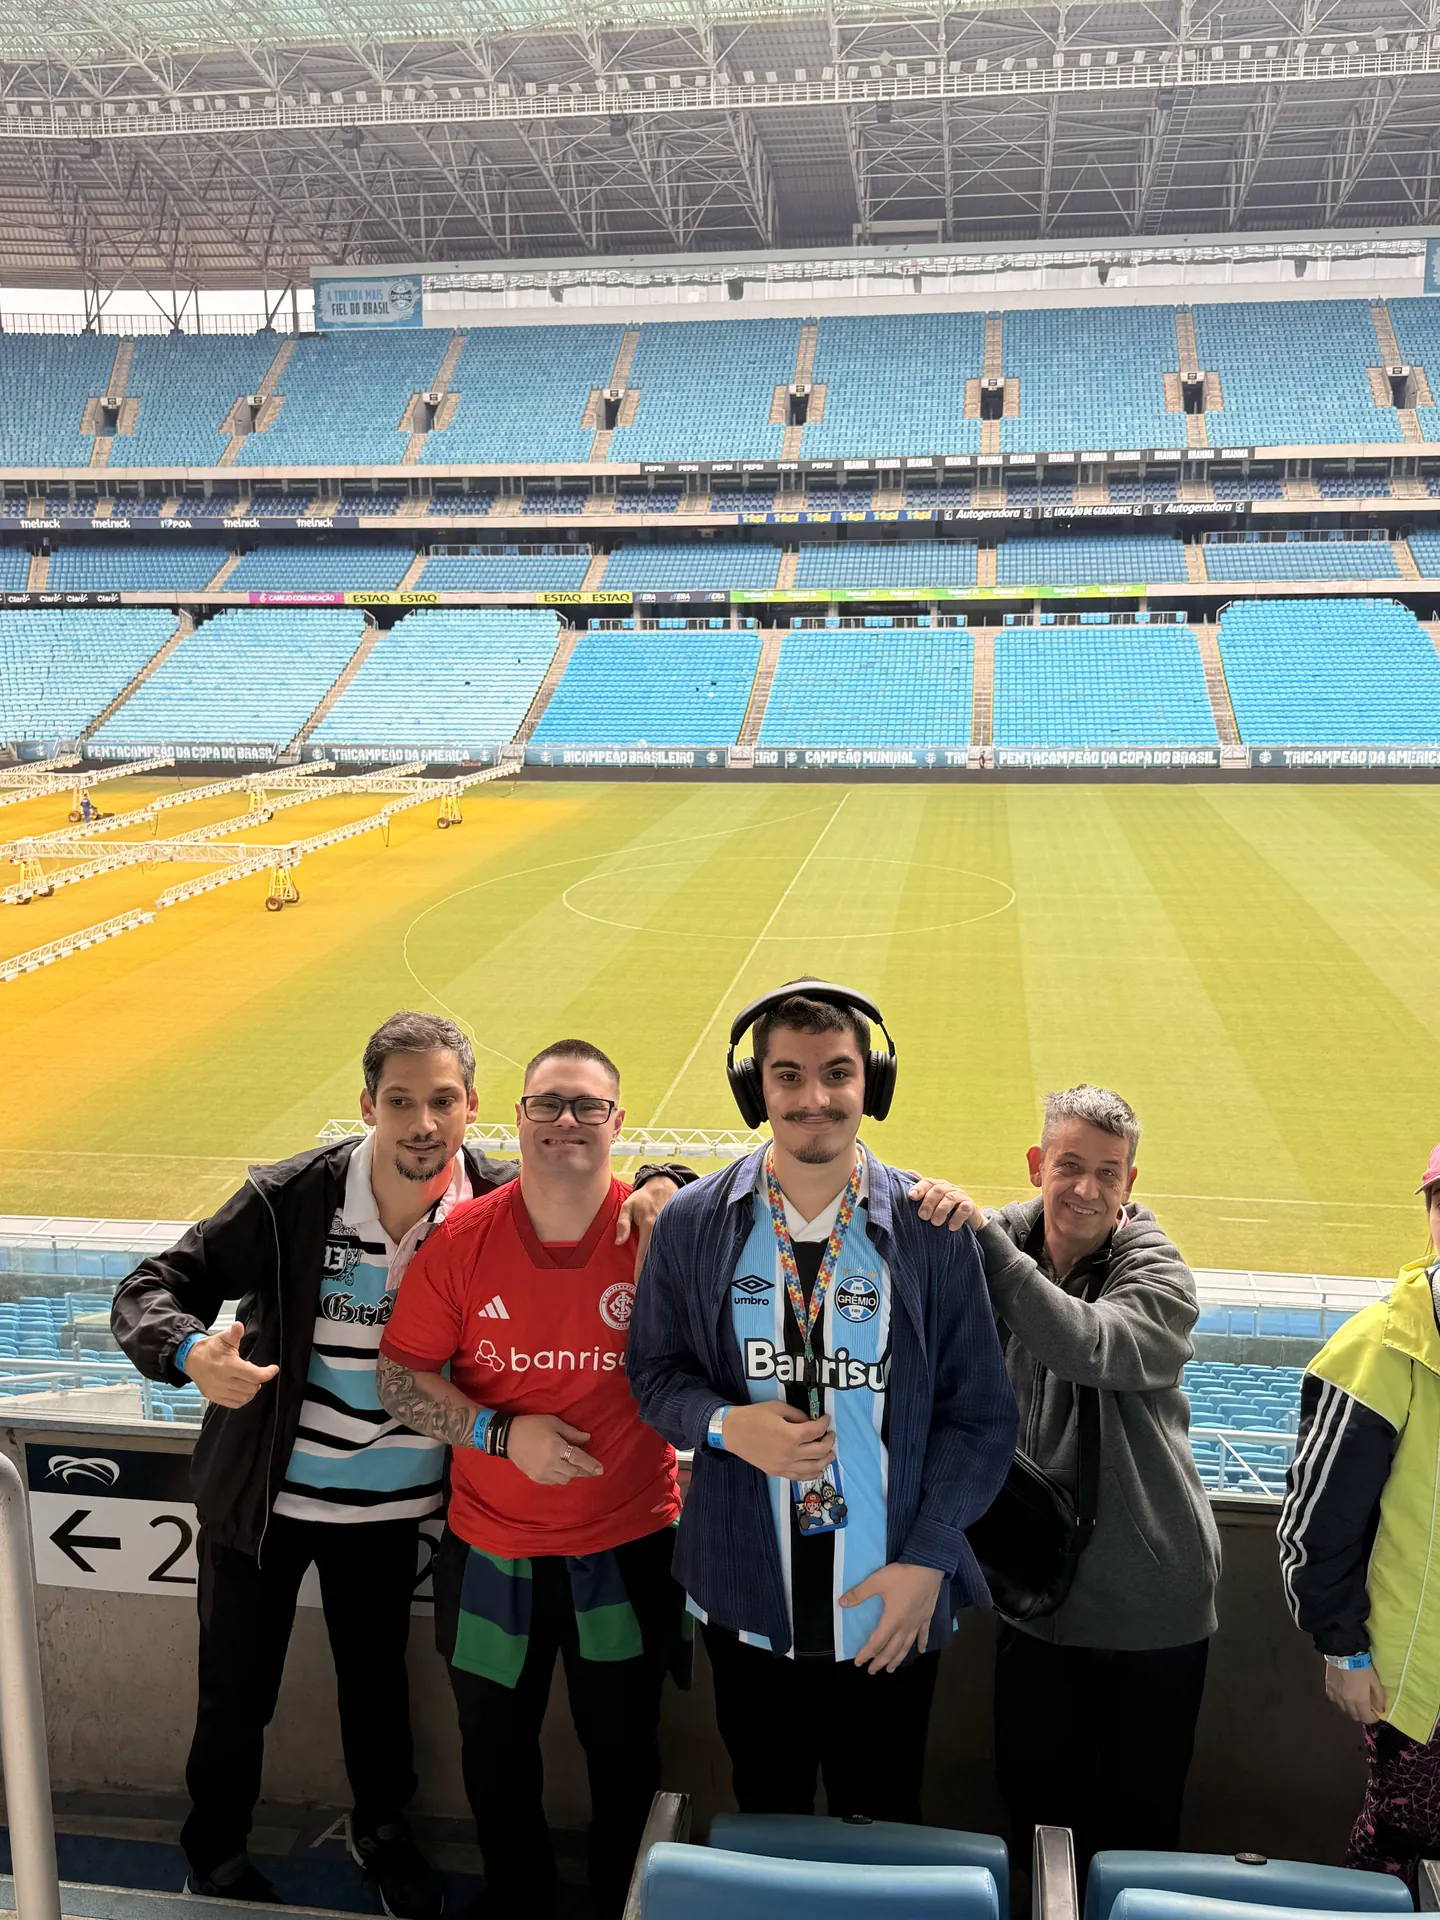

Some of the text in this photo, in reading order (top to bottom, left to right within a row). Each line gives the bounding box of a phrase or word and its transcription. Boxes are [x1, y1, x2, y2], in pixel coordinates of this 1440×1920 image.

[366, 289, 383, 300] MAIS
[332, 302, 390, 316] FIEL DO BRASIL
[1054, 506, 1132, 517] LOCAÇÃO DE GERADORES
[1165, 502, 1232, 514] Autogeradora
[956, 508, 1020, 520] Autogeradora
[20, 519, 60, 528] melnick
[91, 519, 130, 528] melnick
[173, 519, 191, 528] POA
[223, 518, 260, 528] melnick
[296, 518, 333, 528] melnick
[8, 594, 30, 603] Claro
[39, 594, 61, 602] Claro
[66, 594, 87, 602] Claro
[97, 594, 118, 602] Claro
[353, 594, 390, 603] ESTAQ
[401, 594, 437, 603] ESTAQ
[544, 594, 581, 603] ESTAQ
[592, 593, 630, 602] ESTAQ
[176, 746, 190, 759] DA
[191, 746, 220, 759] COPA
[221, 747, 236, 759] DO
[237, 747, 274, 760] BRASIL
[405, 749, 419, 760] DA
[629, 752, 695, 764] BRASILEIRO
[805, 748, 862, 764] CAMPEÃO
[1101, 751, 1118, 764] DA
[1120, 751, 1152, 764] COPA
[1154, 751, 1170, 764] DO
[1172, 751, 1217, 764] BRASIL
[1369, 750, 1386, 764] DA
[734, 1296, 769, 1306] umbro
[838, 1293, 876, 1306] GRÊMIO
[148, 1515, 196, 1584] 2
